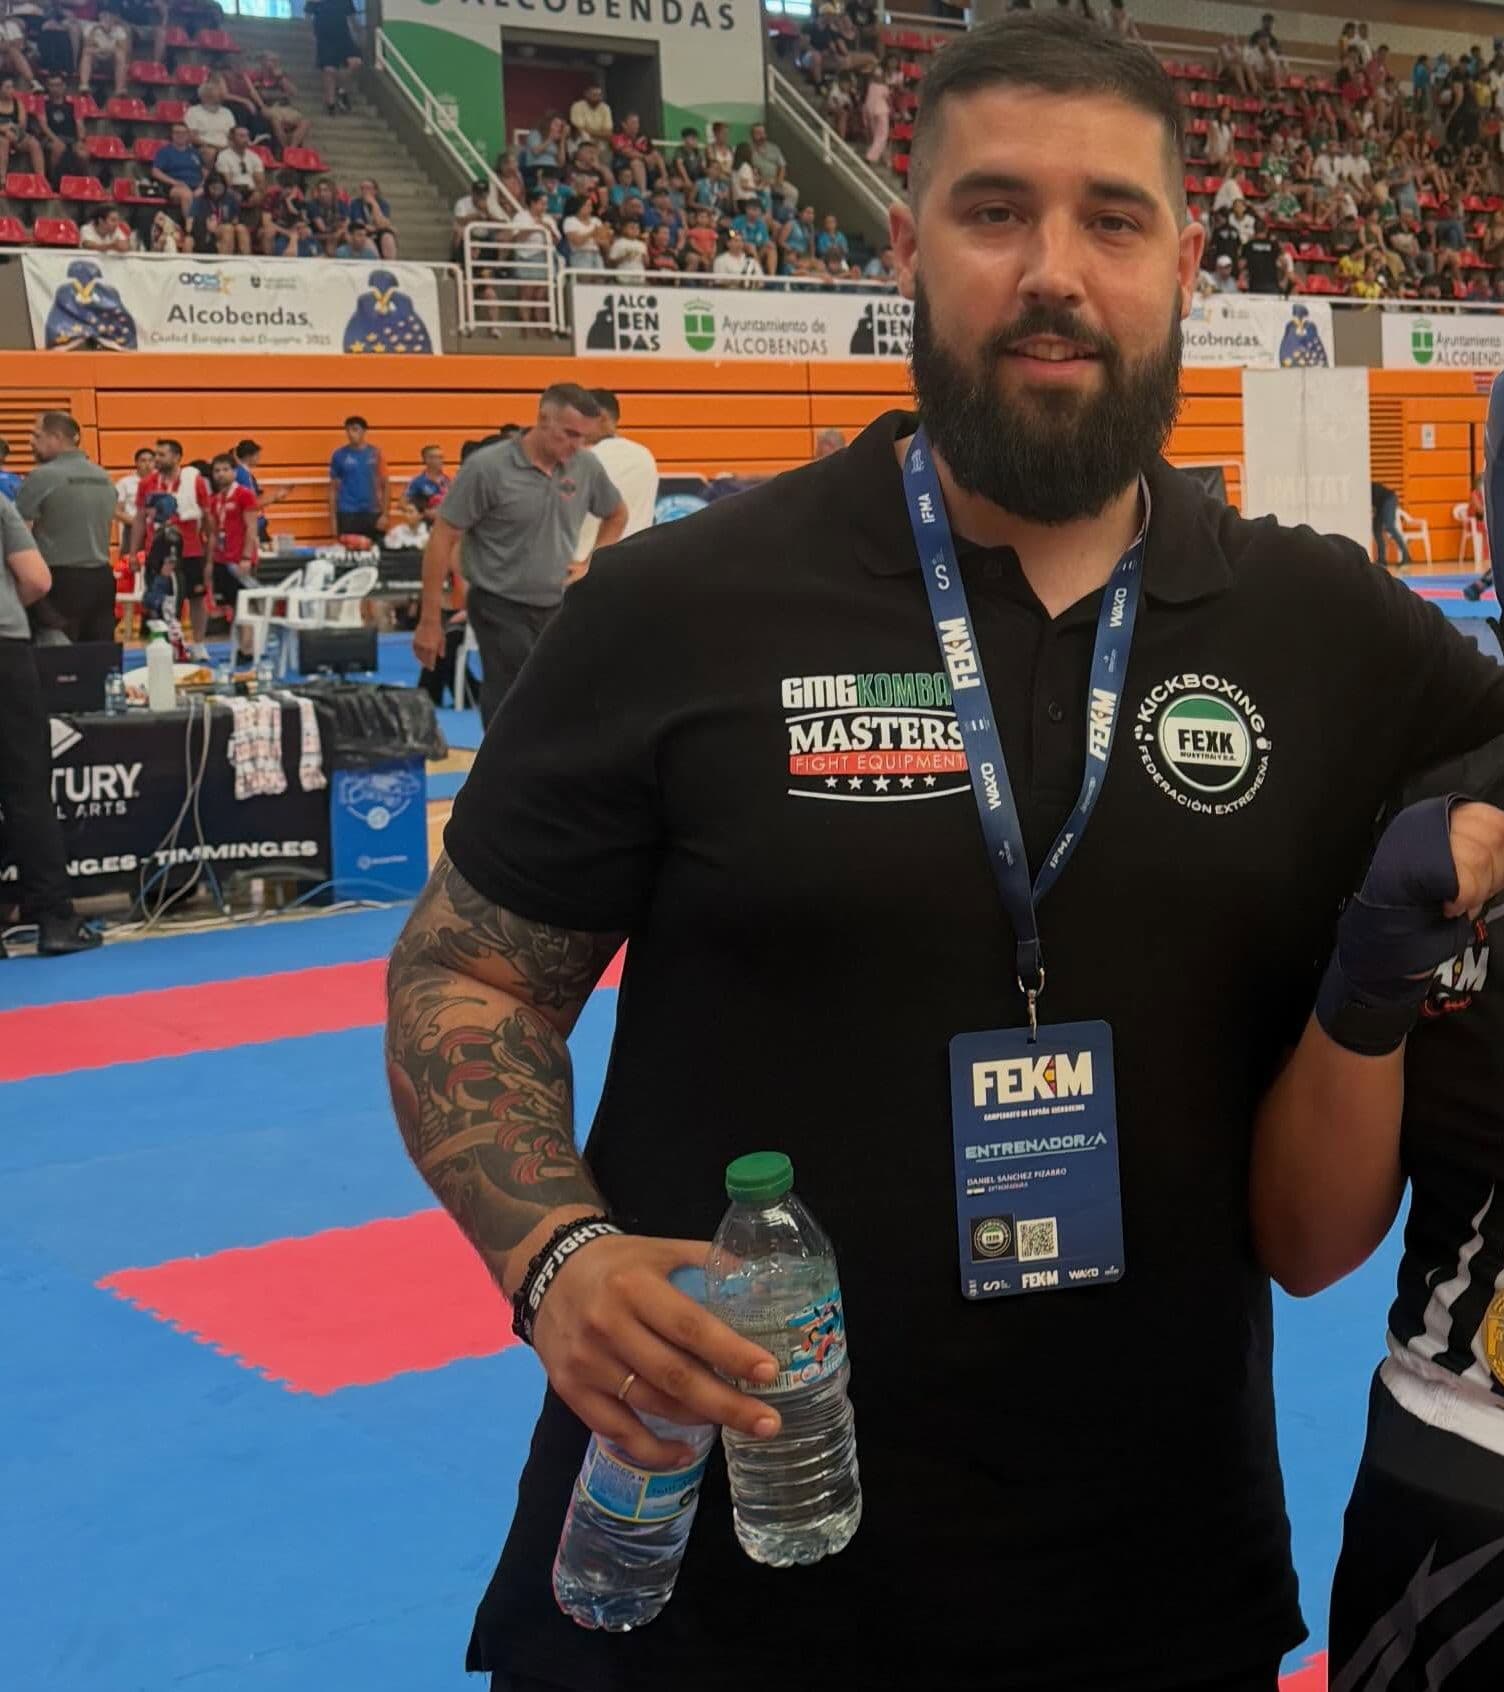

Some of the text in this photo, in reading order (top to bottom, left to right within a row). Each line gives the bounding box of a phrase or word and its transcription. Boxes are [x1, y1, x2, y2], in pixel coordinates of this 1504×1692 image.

[617, 295, 658, 310] ALCO
[618, 312, 660, 331] BEN
[722, 316, 826, 335] Ayuntamiento de
[619, 334, 661, 352] DAS
[722, 338, 828, 356] ALCOBENDAS
[938, 617, 981, 691] FEKM
[1137, 672, 1266, 734] KICKBOXING
[789, 715, 965, 756] MASTERS
[1088, 687, 1119, 764] FEKM
[1177, 728, 1235, 754] FEXK
[795, 753, 965, 772] FIGHT EQUIPMENT
[971, 1051, 1094, 1107] FEKM
[964, 1132, 1108, 1160] ENTRENADOR/A
